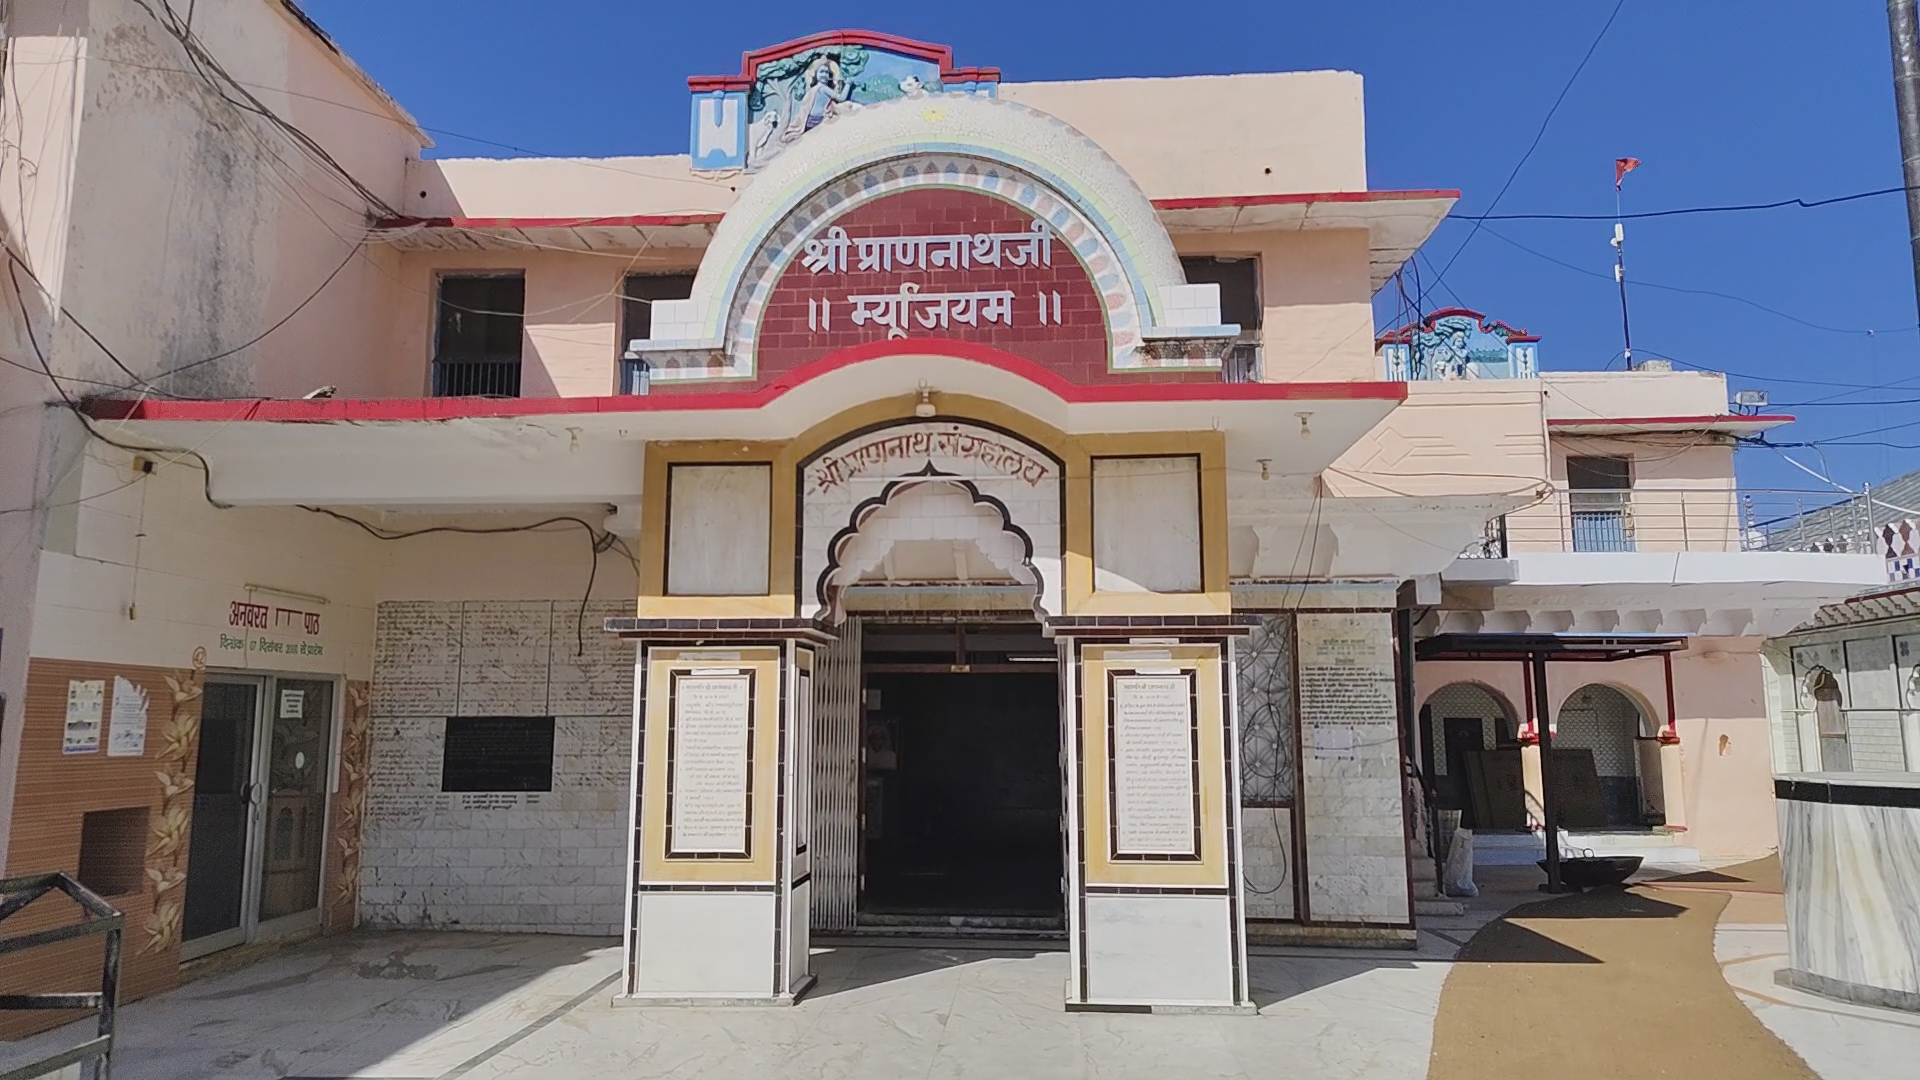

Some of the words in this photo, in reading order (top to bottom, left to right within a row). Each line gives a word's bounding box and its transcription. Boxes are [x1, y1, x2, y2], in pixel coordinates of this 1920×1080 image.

[801, 226, 852, 274] श्री
[852, 219, 1056, 274] प्राणनाथजी
[847, 282, 1016, 341] म्यूजियम
[229, 600, 269, 630] अनवरत
